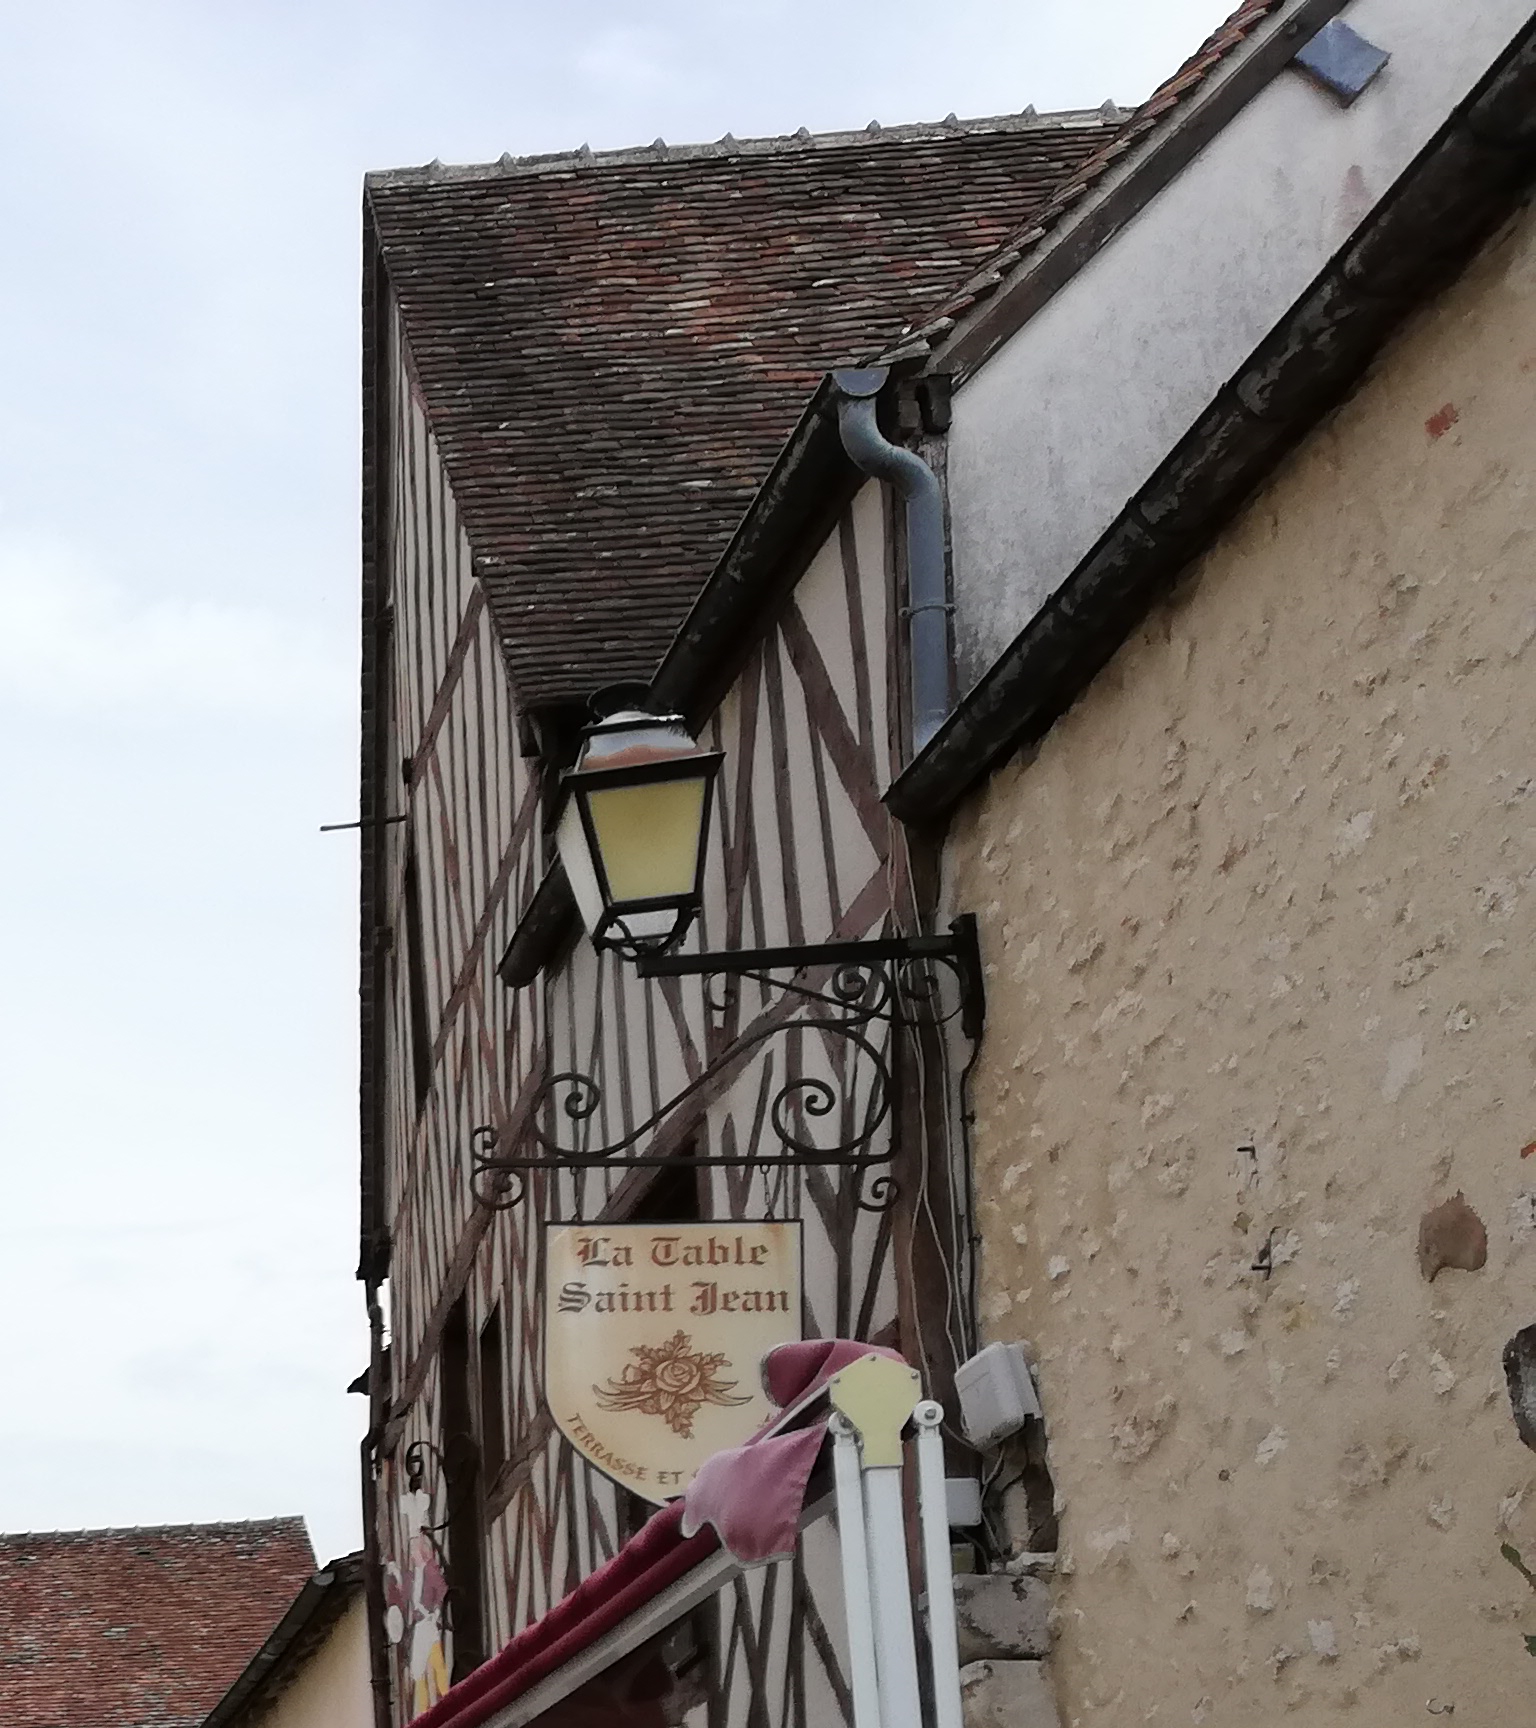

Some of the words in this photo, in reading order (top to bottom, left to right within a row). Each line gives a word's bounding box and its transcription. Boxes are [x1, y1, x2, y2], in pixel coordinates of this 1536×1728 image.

[576, 1236, 634, 1268] La
[649, 1235, 770, 1268] Table
[557, 1281, 676, 1314] Saint
[688, 1280, 790, 1316] Jean
[565, 1412, 649, 1482] TERRASSE
[656, 1469, 685, 1485] ET
